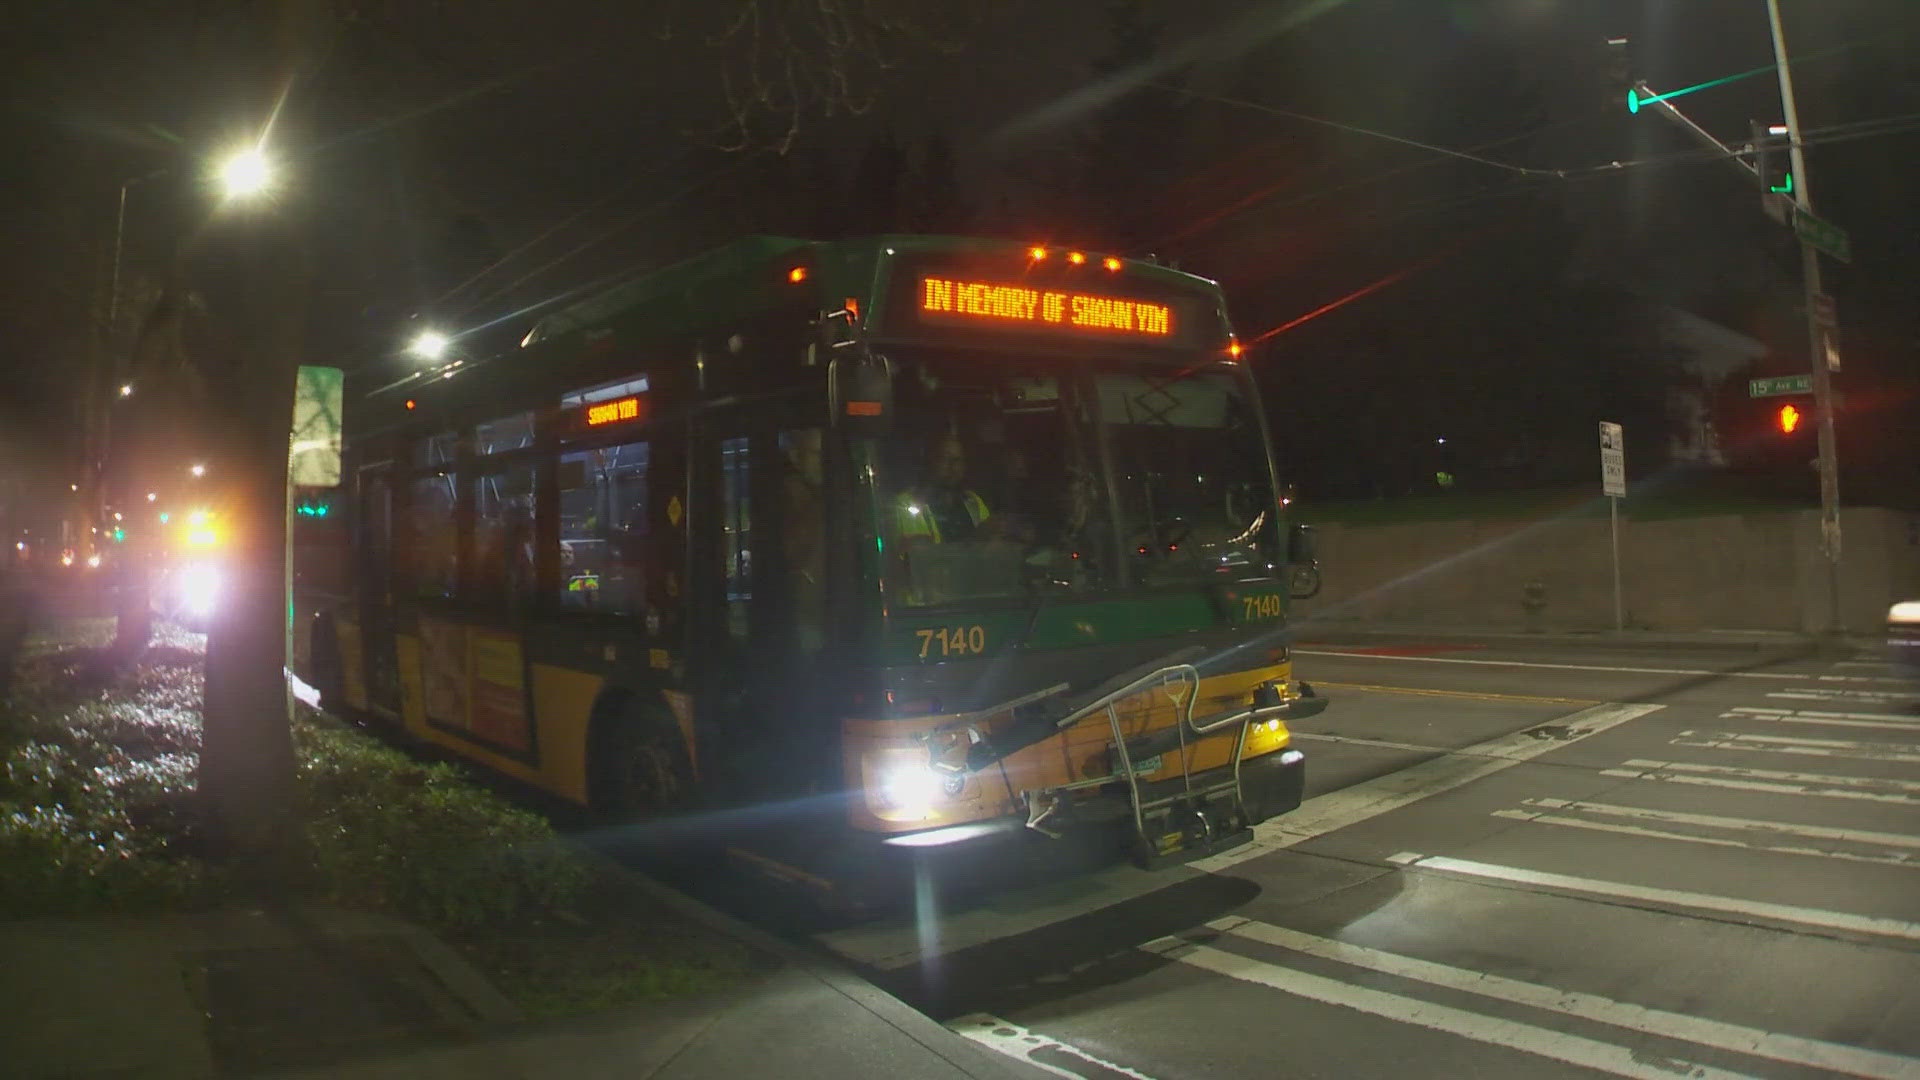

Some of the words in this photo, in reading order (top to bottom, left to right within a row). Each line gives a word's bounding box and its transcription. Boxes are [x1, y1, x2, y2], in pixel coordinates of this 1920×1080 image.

[924, 278, 951, 311] IN
[957, 282, 1038, 320] MEMORY
[1042, 292, 1067, 322] OF
[1071, 295, 1133, 329] SHAWN
[1134, 303, 1169, 334] YIM
[619, 398, 638, 419] YIM
[1243, 594, 1280, 620] 7140
[916, 625, 985, 657] 7140
